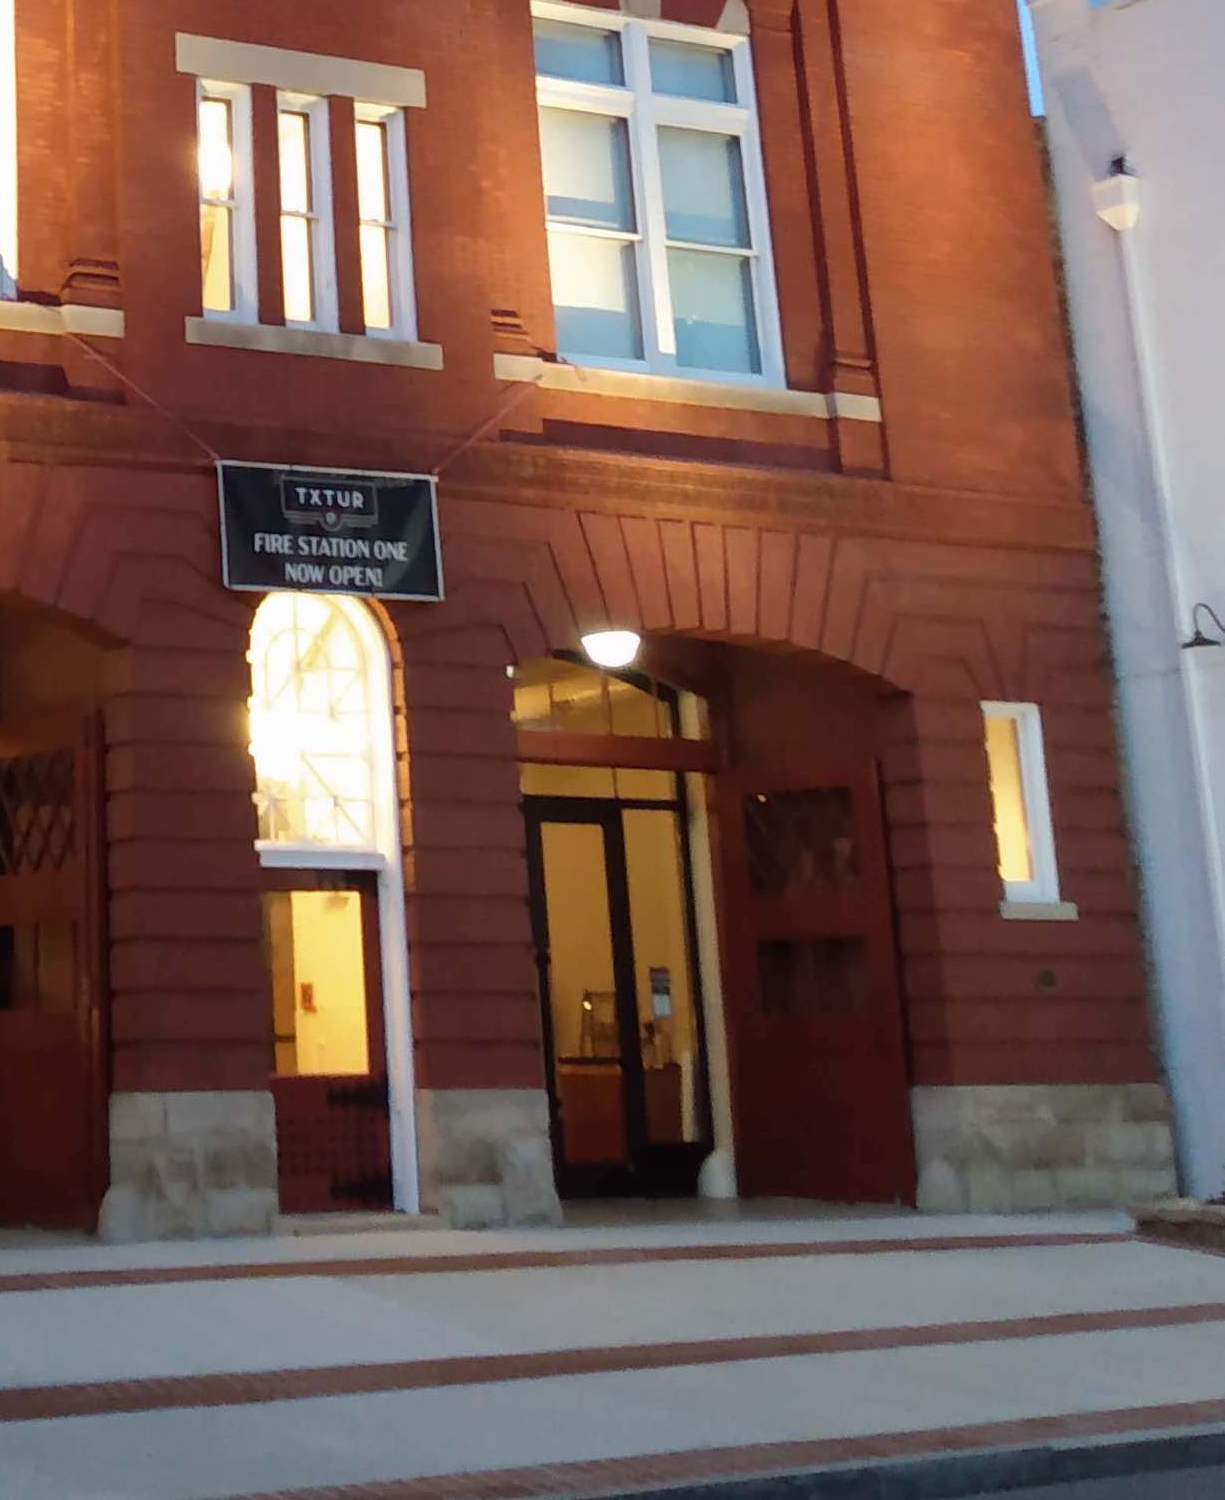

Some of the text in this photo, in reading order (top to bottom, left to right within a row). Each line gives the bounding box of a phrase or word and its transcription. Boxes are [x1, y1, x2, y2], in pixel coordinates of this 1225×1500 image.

[296, 487, 364, 508] TXTUR
[254, 533, 408, 562] FIRE STATION ONE
[285, 563, 383, 587] NOW OPEN!
